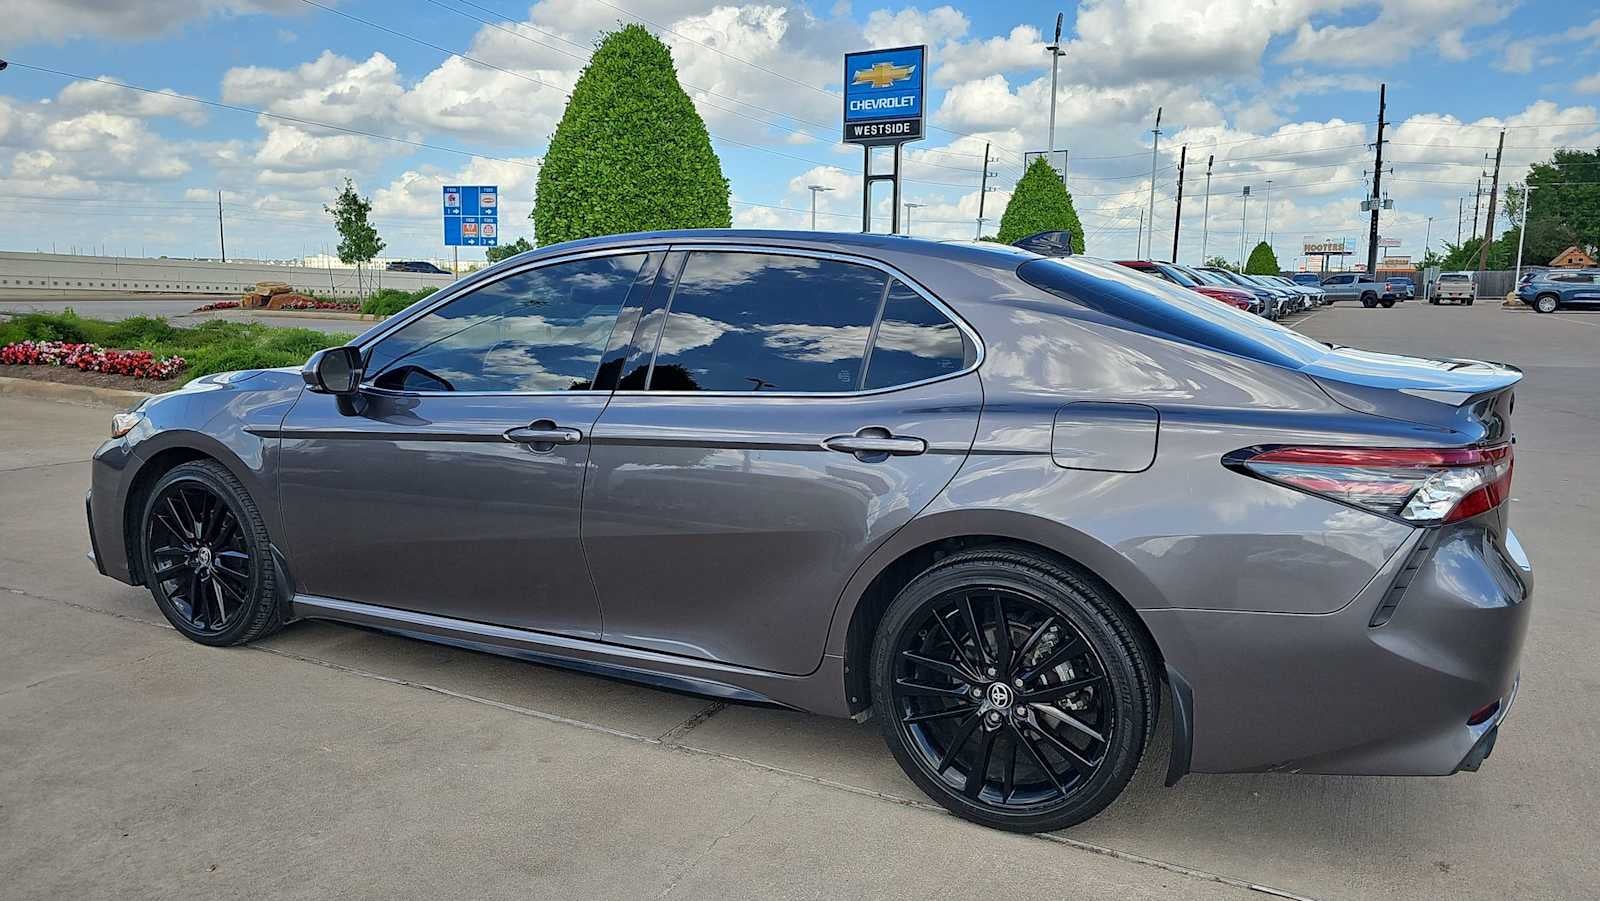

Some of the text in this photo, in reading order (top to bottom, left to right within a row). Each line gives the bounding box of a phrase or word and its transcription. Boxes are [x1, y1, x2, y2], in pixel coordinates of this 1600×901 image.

[850, 95, 915, 111] CHEVROLET
[854, 122, 910, 136] WESTSIDE
[1304, 243, 1344, 251] HOOTERS
